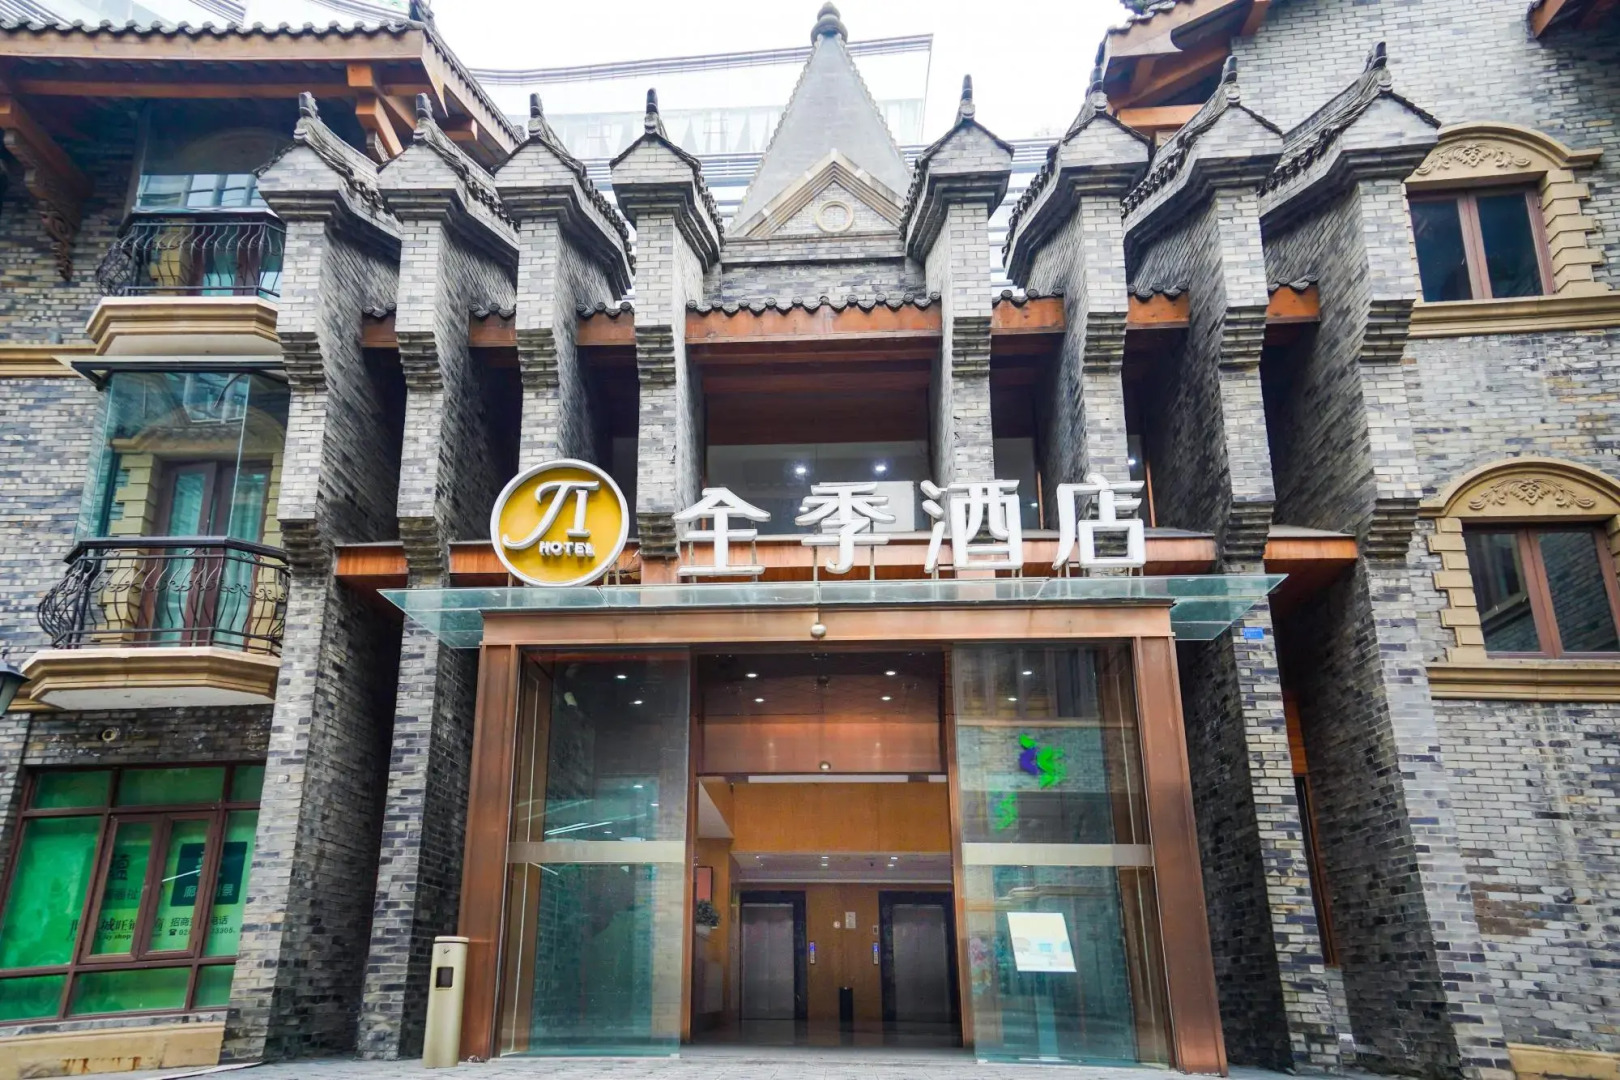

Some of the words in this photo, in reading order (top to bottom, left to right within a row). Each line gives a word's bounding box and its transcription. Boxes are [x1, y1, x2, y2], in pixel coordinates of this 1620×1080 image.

[538, 540, 596, 558] HOTEL
[672, 473, 1146, 576] 全季酒店
